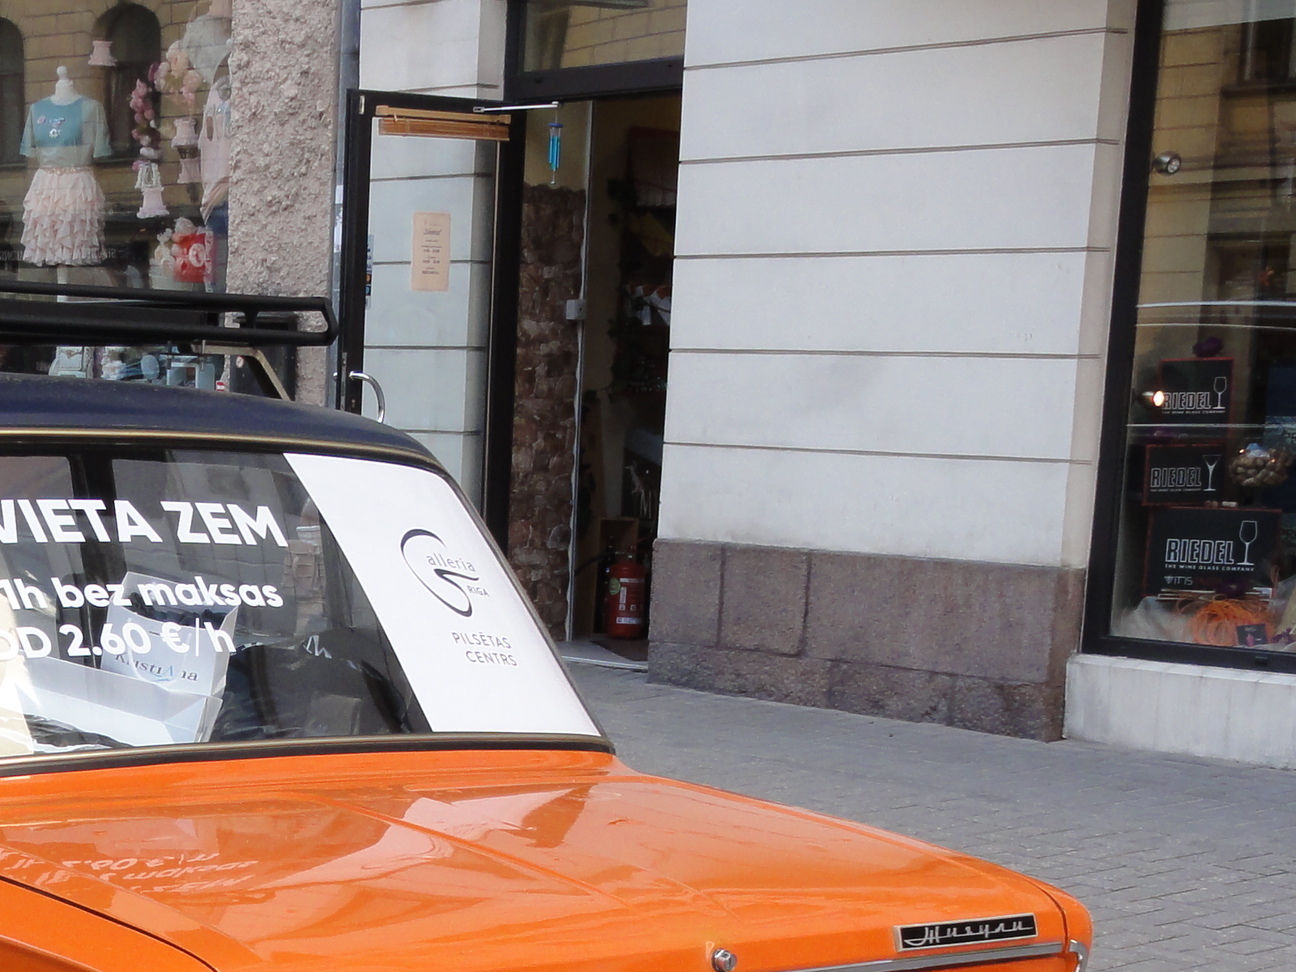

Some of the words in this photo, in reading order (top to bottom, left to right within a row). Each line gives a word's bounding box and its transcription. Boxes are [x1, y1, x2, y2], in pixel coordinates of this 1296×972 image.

[1161, 391, 1212, 410] RIEDEL
[1150, 467, 1202, 488] RIEDEL
[160, 500, 289, 548] ZEM
[1164, 538, 1235, 565] RIEDEL
[50, 577, 133, 608] bez
[136, 575, 284, 608] maksas
[58, 621, 152, 657] 2.60
[451, 631, 512, 650] PILSĒTAS
[465, 650, 518, 667] CENTRS
[904, 920, 1034, 947] Жигули
